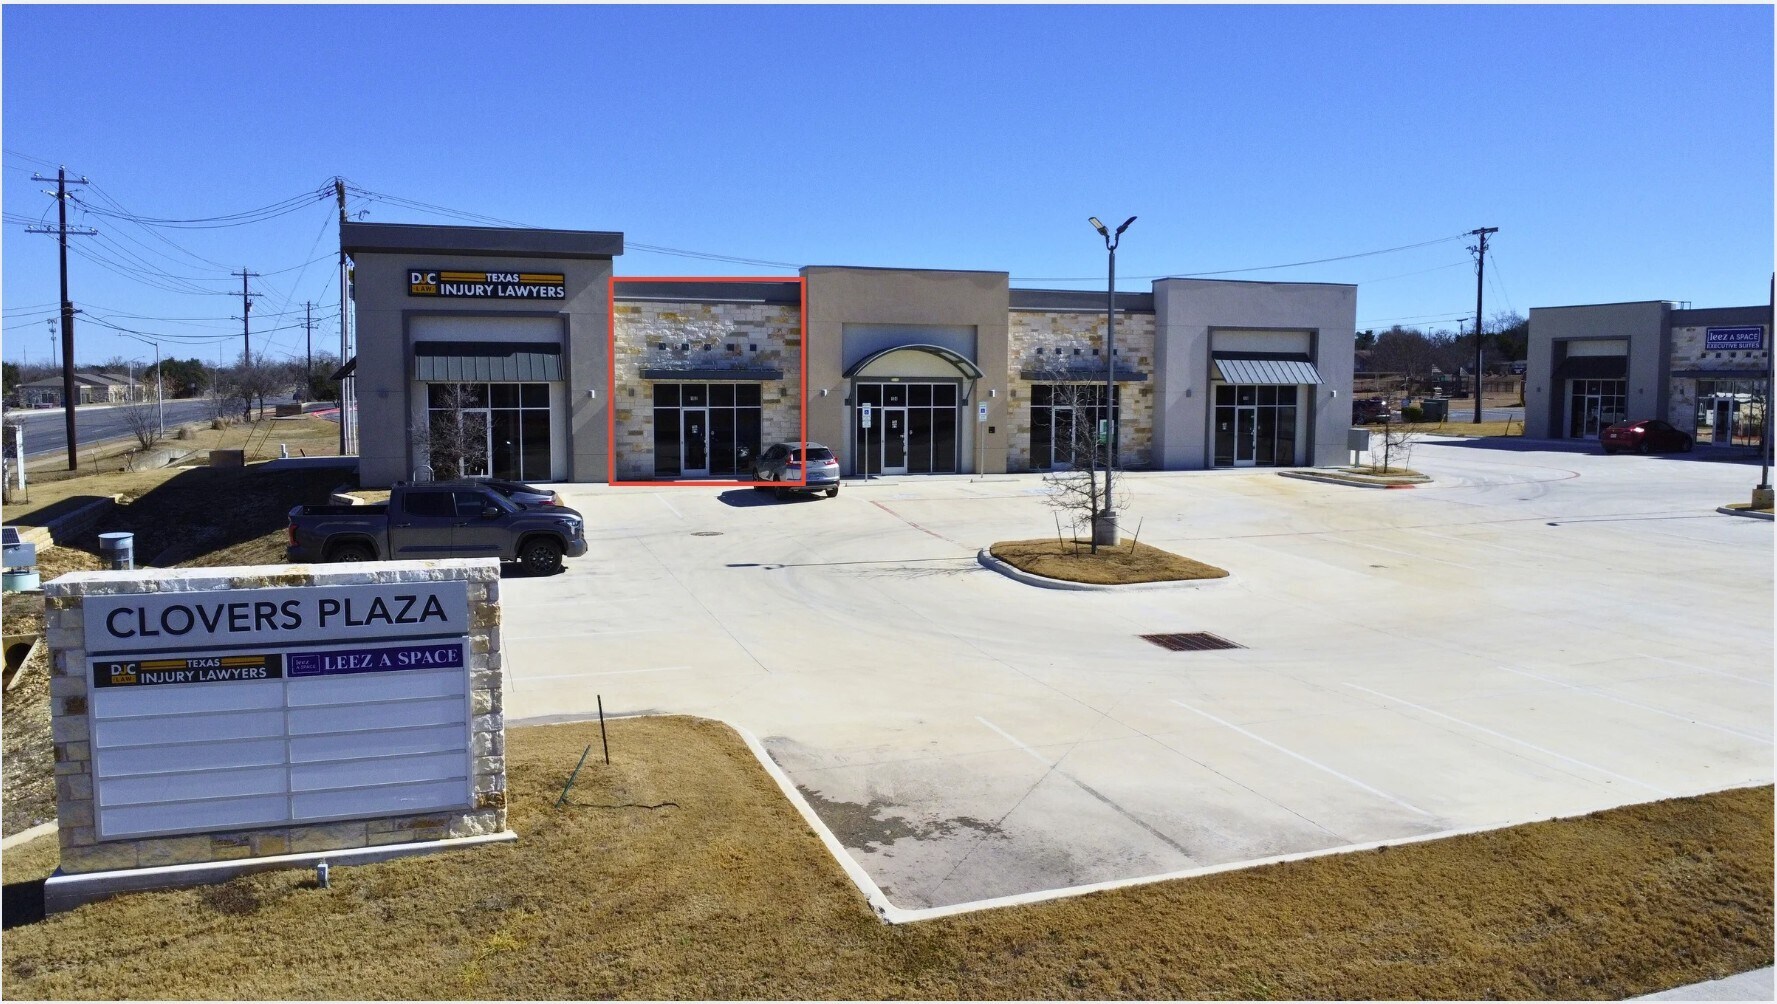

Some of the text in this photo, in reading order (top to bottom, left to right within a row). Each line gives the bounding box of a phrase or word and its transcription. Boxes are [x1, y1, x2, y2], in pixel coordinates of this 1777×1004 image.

[411, 272, 436, 284] DJC
[485, 273, 519, 283] TEXAS
[440, 283, 565, 298] INJURY LAWYERS
[106, 594, 448, 639] CLOVERS PLAZA
[187, 658, 220, 668] TEXAS
[325, 649, 458, 670] LEEZ A SPACE
[111, 663, 136, 675] DJC
[141, 667, 267, 684] INJURY LAWYERS
